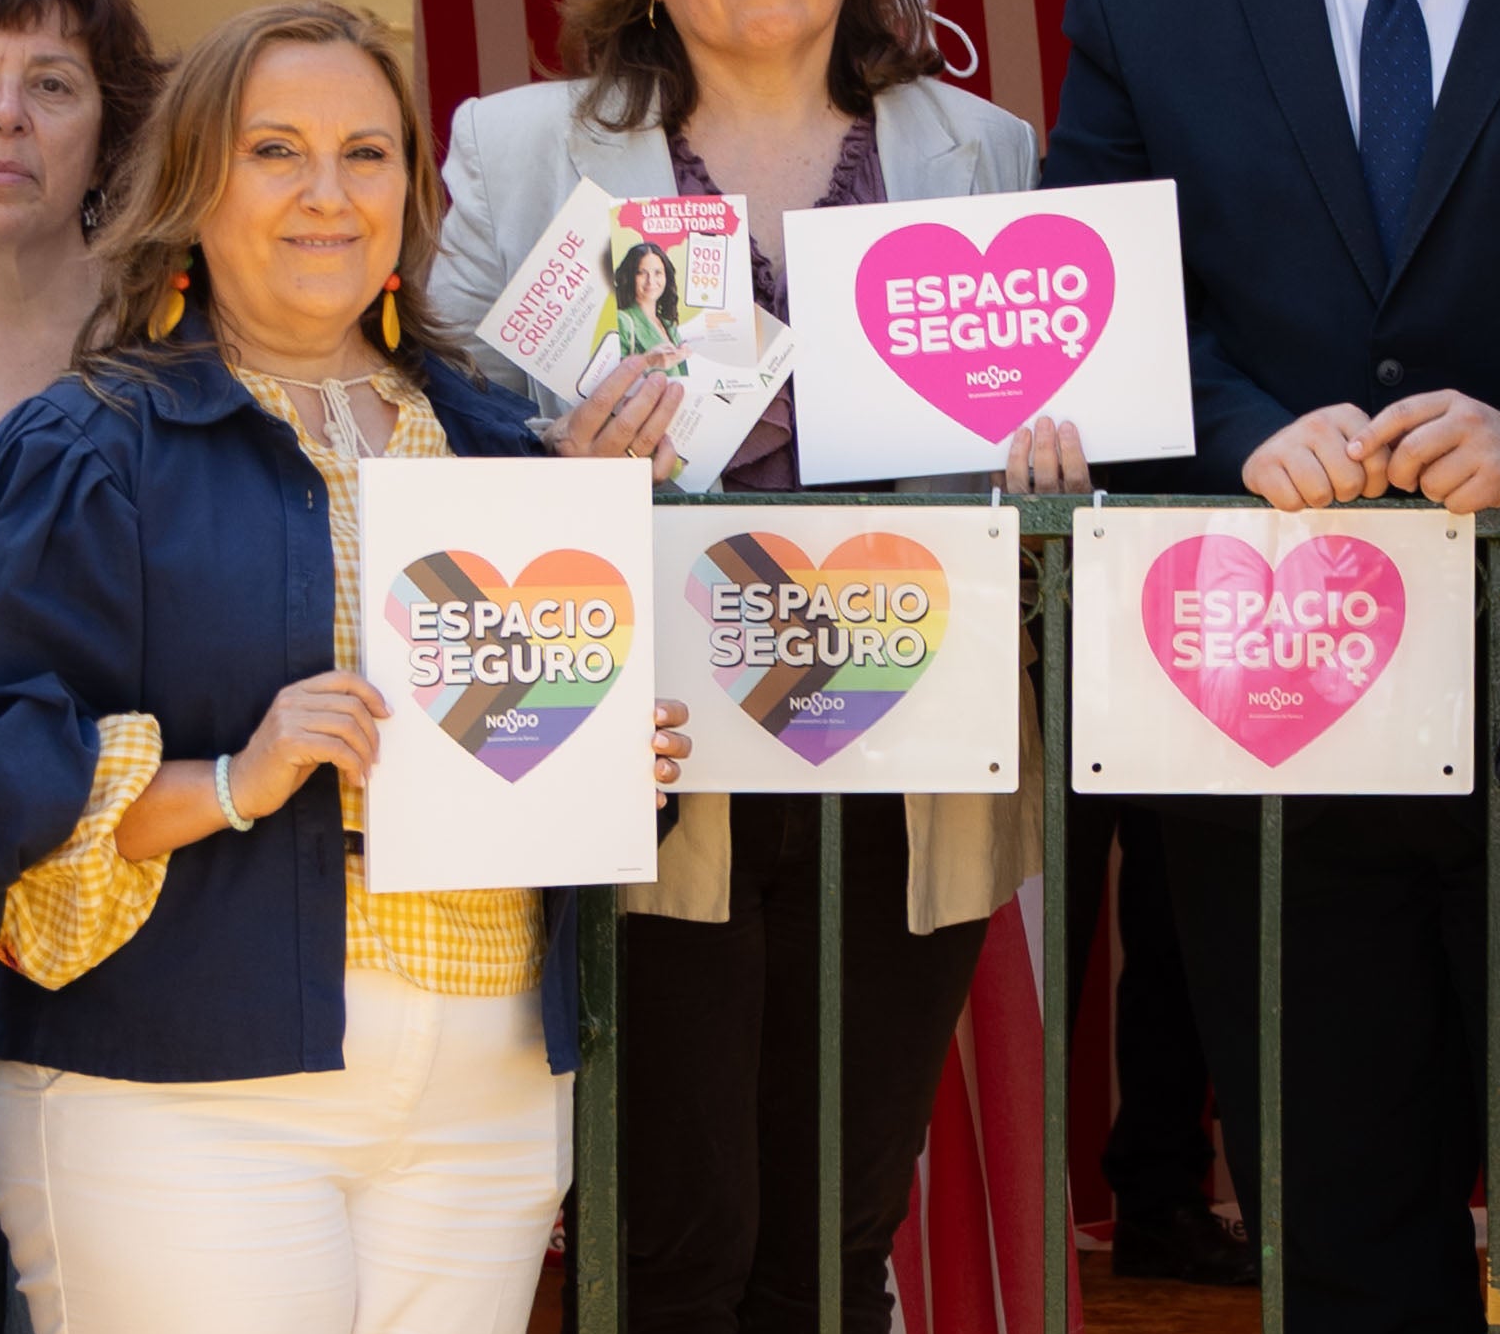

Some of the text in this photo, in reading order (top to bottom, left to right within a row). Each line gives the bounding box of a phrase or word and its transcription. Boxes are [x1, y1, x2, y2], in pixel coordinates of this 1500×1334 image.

[642, 200, 725, 217] UN TELÉFONO
[683, 218, 725, 230] TODAS
[692, 261, 720, 275] 200
[693, 247, 721, 261] 900
[500, 231, 586, 343] CENTROS DE
[692, 275, 718, 288] 999
[886, 264, 1089, 314] ESPACIO
[518, 264, 590, 356] CRISIS 24H
[888, 305, 1090, 359] SEGURO
[410, 599, 616, 641] ESPACIO
[711, 582, 930, 623] ESPACIO
[1173, 590, 1378, 627] ESPACIO
[409, 642, 614, 687] SEGURO
[710, 626, 927, 668] SEGURO
[1172, 631, 1376, 687] SEGURO
